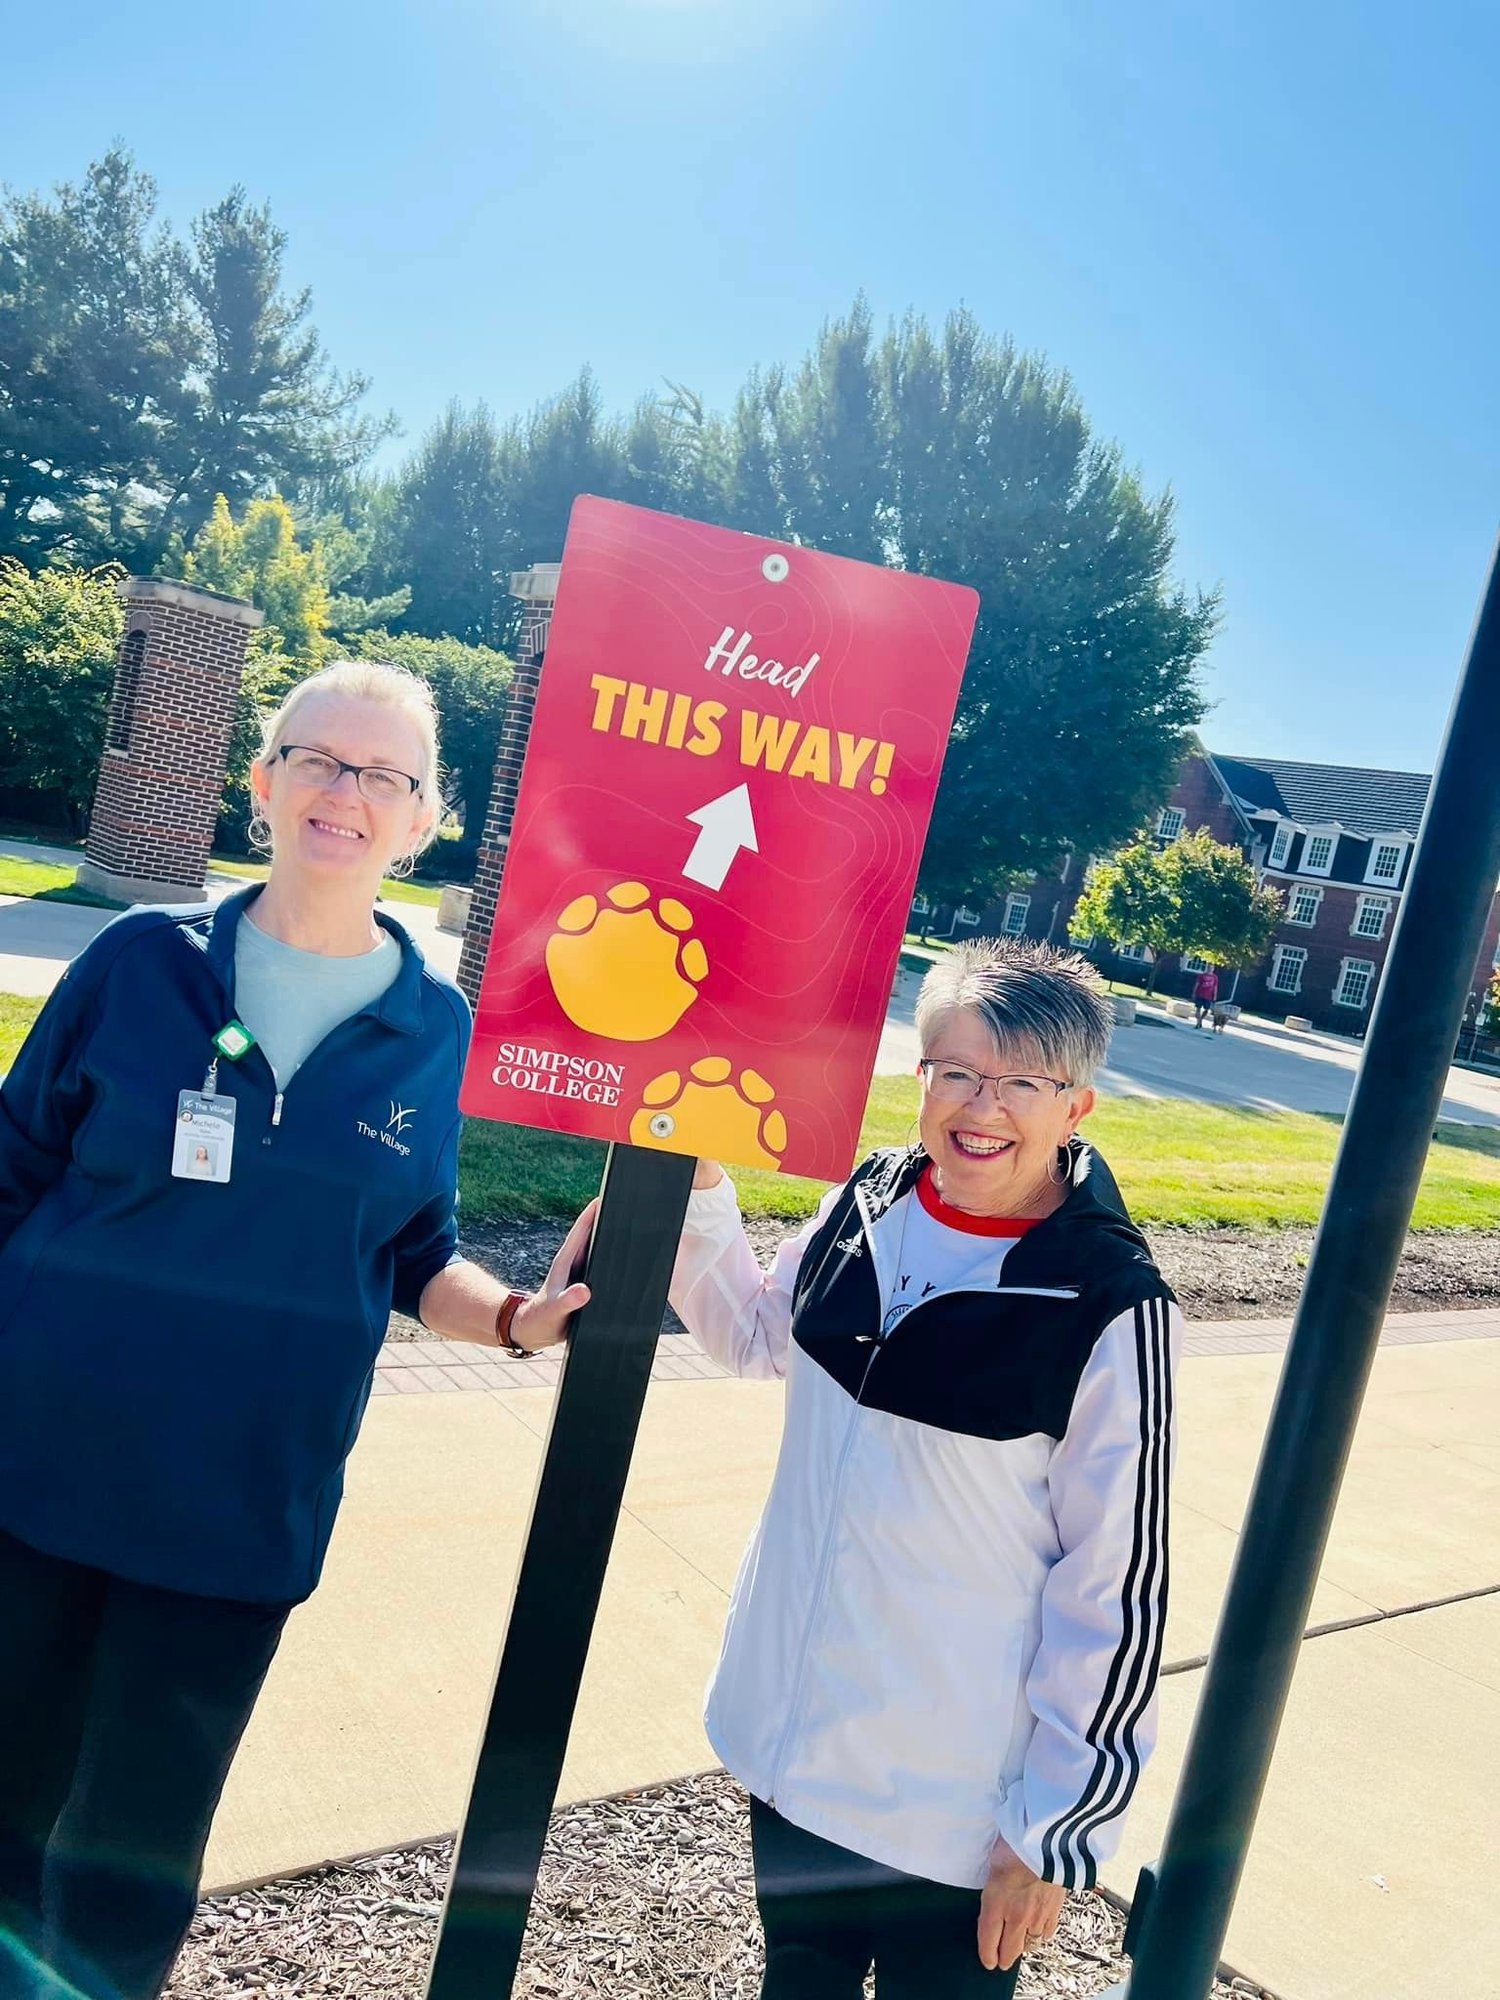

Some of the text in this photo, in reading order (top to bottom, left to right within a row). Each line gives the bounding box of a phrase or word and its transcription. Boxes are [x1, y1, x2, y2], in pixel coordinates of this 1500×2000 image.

[704, 626, 821, 698] Head
[590, 674, 896, 796] THIS WAY!
[496, 1042, 626, 1085] SIMPSON
[194, 1101, 208, 1111] The
[491, 1065, 622, 1107] COLLEGE
[356, 1121, 411, 1156] The Village
